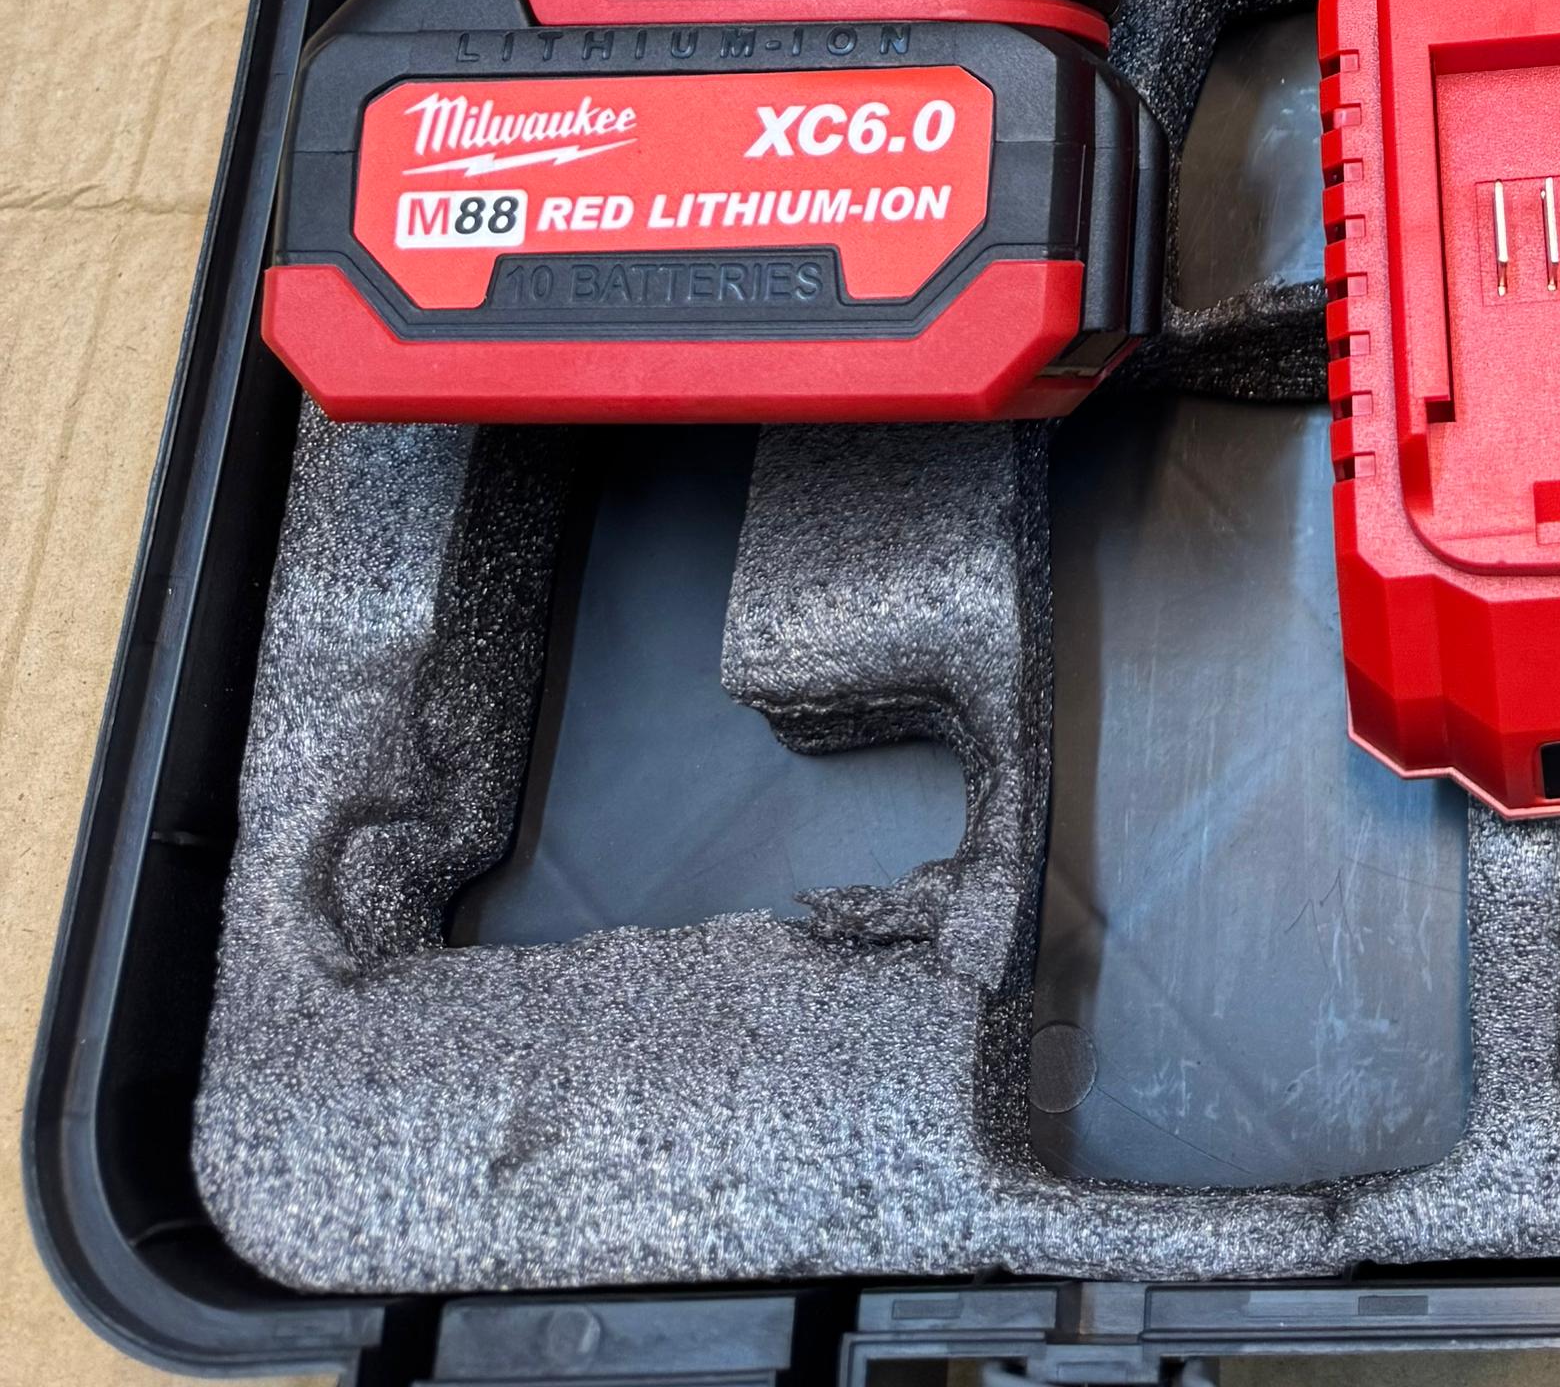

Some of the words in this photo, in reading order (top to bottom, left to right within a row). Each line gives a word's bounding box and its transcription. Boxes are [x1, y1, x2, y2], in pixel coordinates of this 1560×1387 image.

[456, 25, 911, 63] LITHIUM-ION
[403, 91, 638, 157] Milwaukee
[743, 98, 957, 160] XC6.0
[406, 193, 520, 240] M88
[535, 195, 635, 233] RED
[646, 184, 953, 230] LITHIUM-ION
[505, 264, 555, 302] 10
[569, 261, 824, 302] BATTERIES
